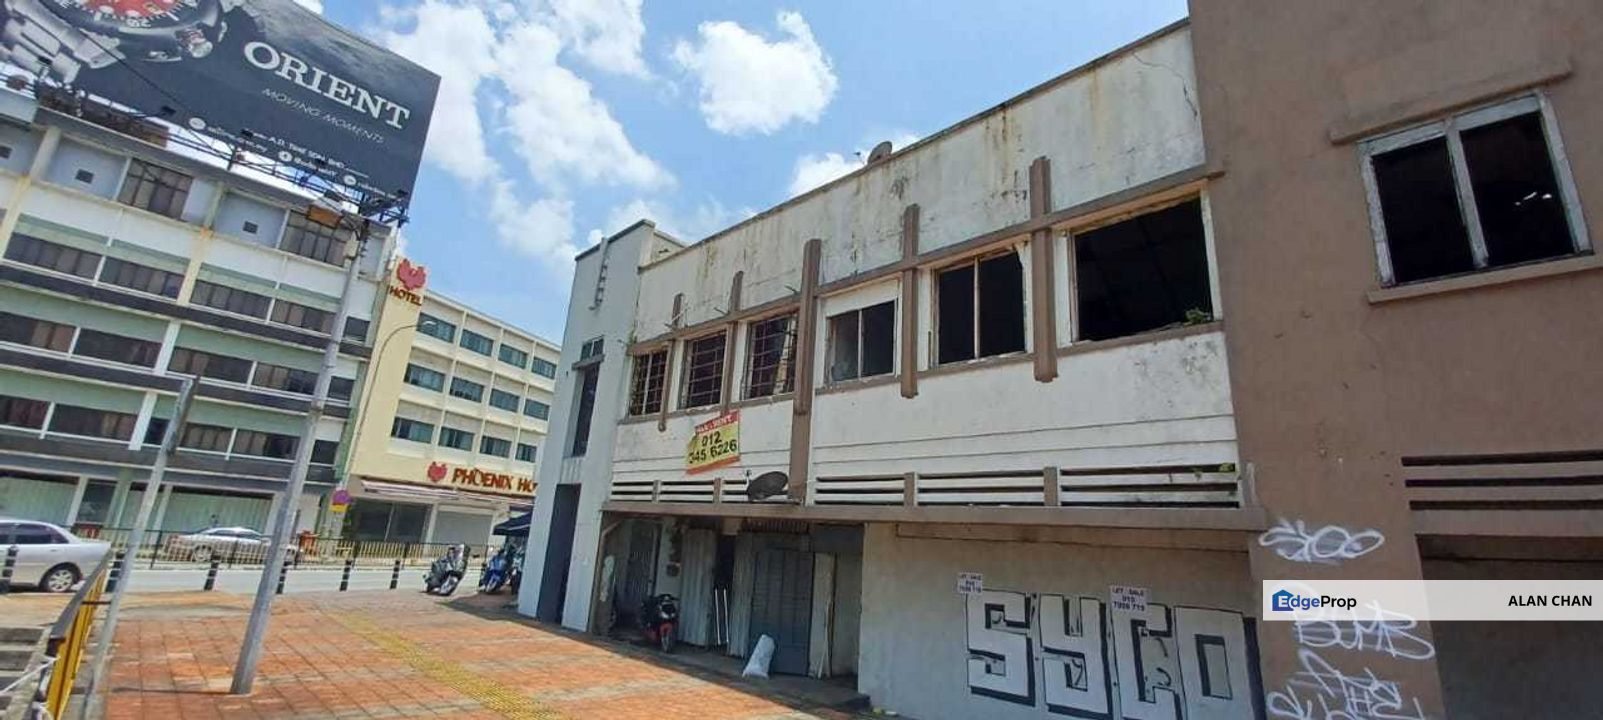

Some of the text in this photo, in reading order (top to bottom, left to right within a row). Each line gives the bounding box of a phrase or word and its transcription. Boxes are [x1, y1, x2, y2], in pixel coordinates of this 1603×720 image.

[244, 42, 411, 129] ORIENT
[262, 88, 385, 144] MOVING MOMENTS
[389, 286, 422, 306] HOTEL
[701, 431, 722, 447] 012
[710, 439, 737, 458] 6226
[452, 468, 513, 490] PHOENIX
